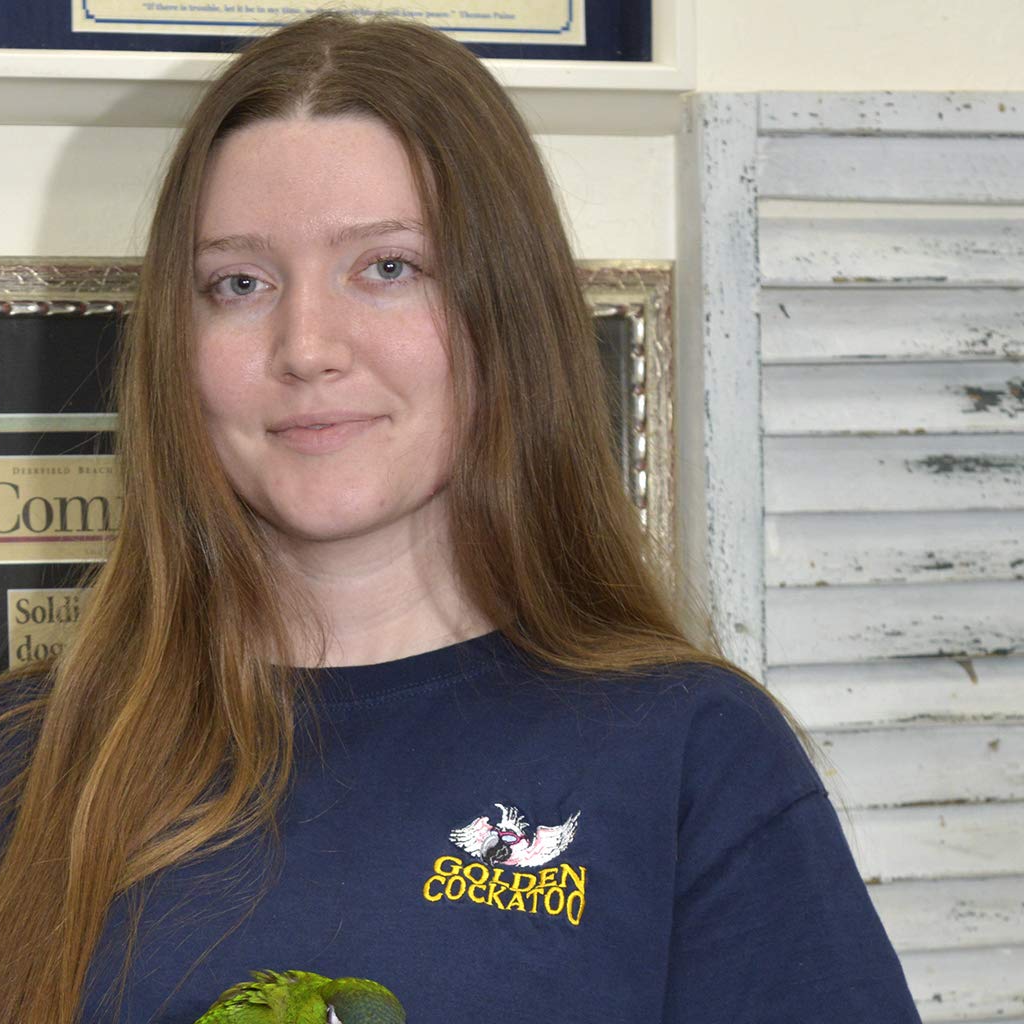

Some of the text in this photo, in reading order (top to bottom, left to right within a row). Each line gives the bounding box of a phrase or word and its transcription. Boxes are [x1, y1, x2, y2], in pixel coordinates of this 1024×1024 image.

[77, 465, 114, 475] BEACH
[16, 595, 80, 625] Soldi
[433, 855, 587, 894] GOLDEN
[423, 875, 587, 926] COCKATOO
